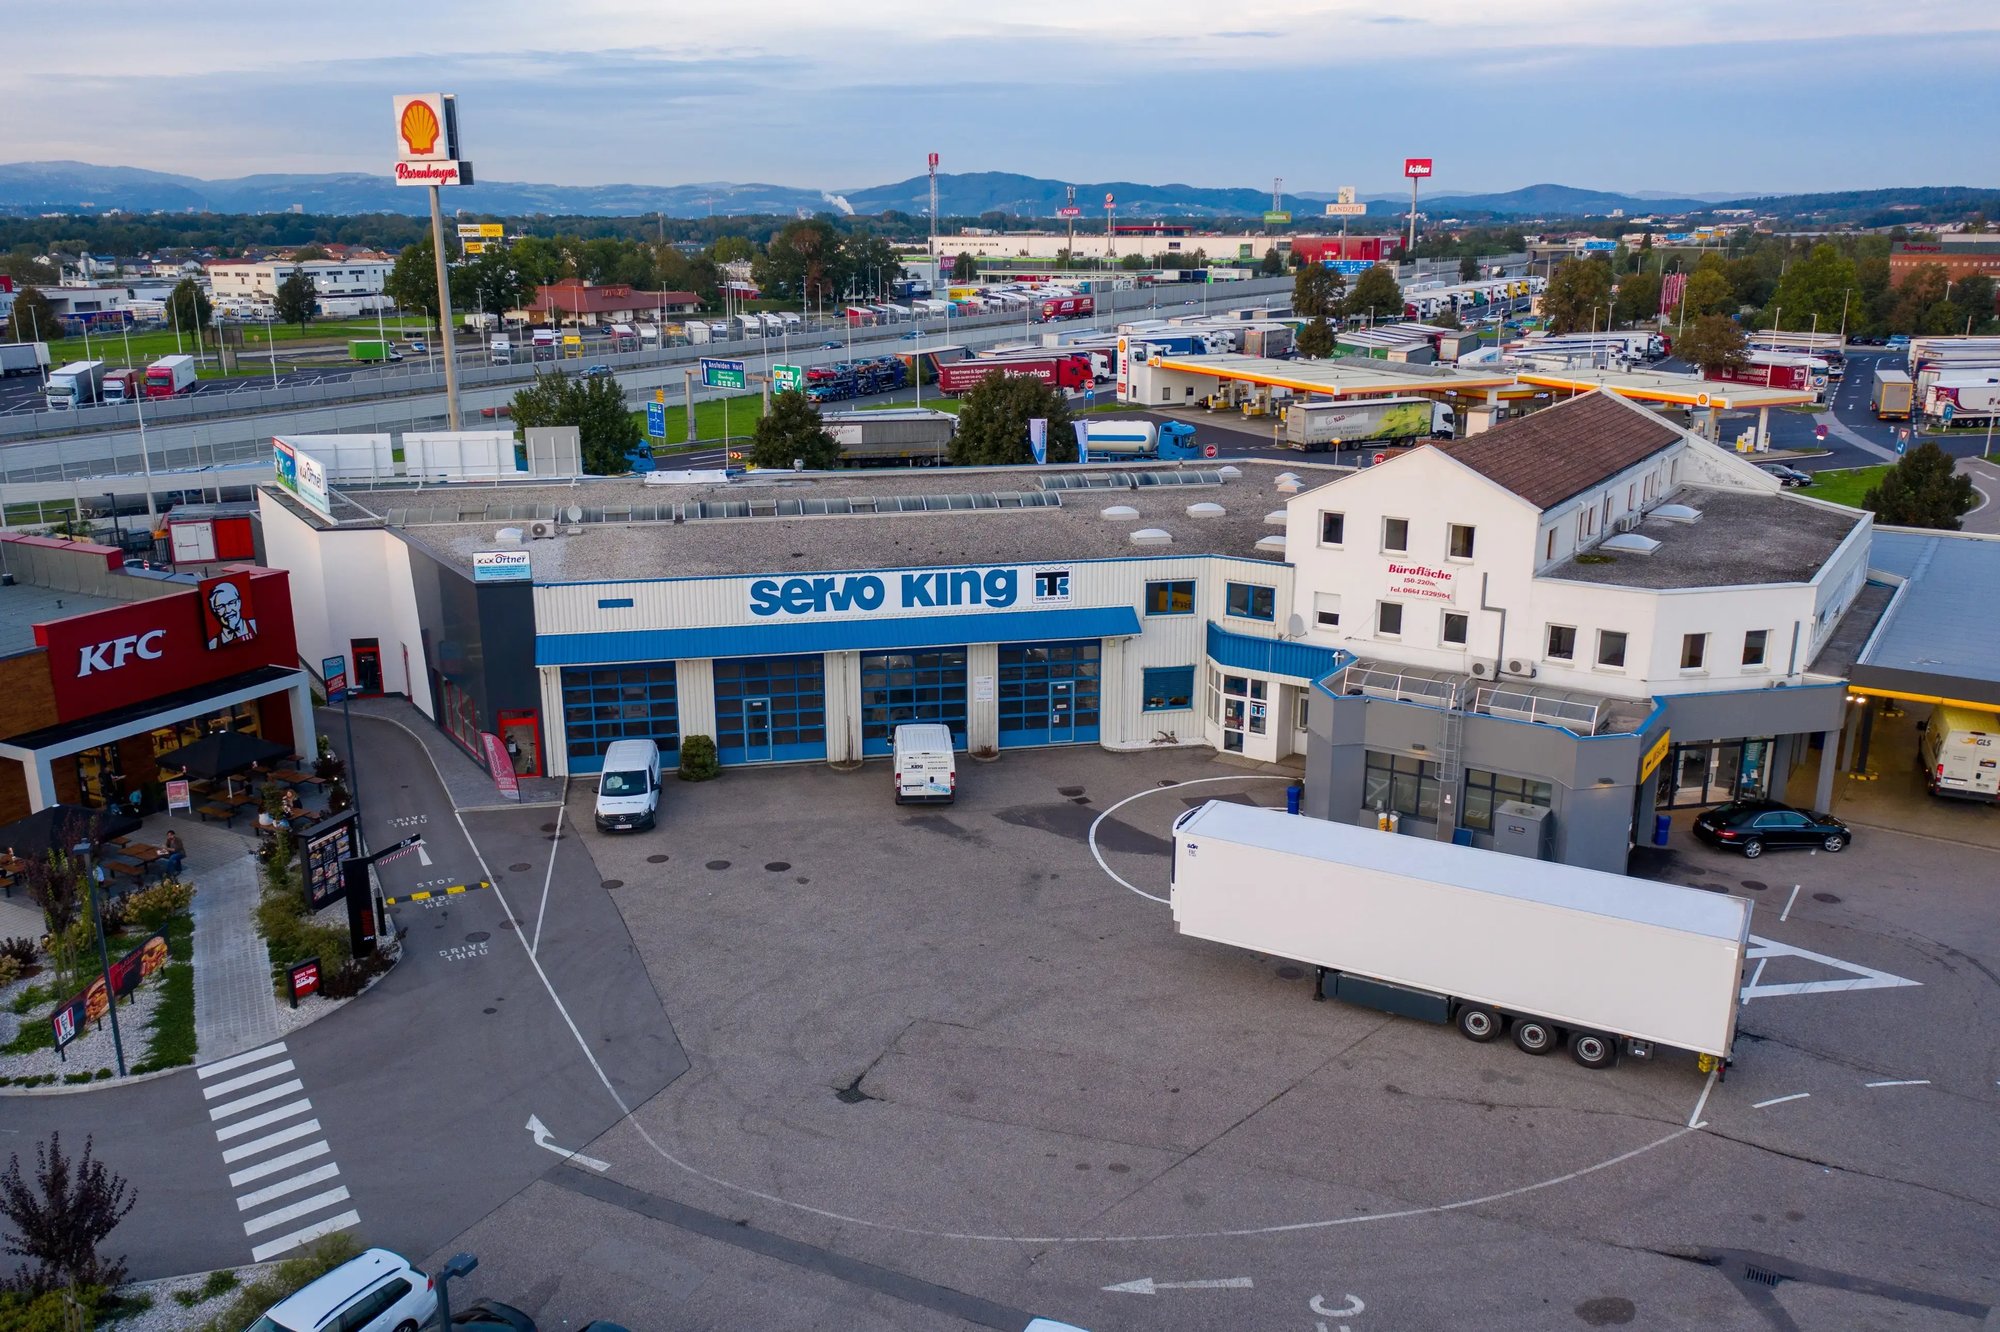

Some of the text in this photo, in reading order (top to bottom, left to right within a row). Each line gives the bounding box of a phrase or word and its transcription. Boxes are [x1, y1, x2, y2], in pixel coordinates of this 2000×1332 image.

[395, 162, 458, 185] Rosenberger
[1408, 164, 1430, 174] kika
[1328, 205, 1363, 213] LANDZEIT
[231, 308, 240, 316] GLS
[1333, 415, 1346, 423] NAD
[495, 555, 526, 564] Ortner
[1388, 564, 1452, 580] Bürofläche
[749, 575, 886, 616] servo
[77, 629, 164, 678] KFC
[386, 814, 428, 825] DRIVE
[393, 819, 428, 828] THRU
[416, 877, 455, 888] STOP
[439, 942, 489, 957] DRIVE
[446, 949, 489, 962] THRU
[61, 1031, 73, 1042] KFC
